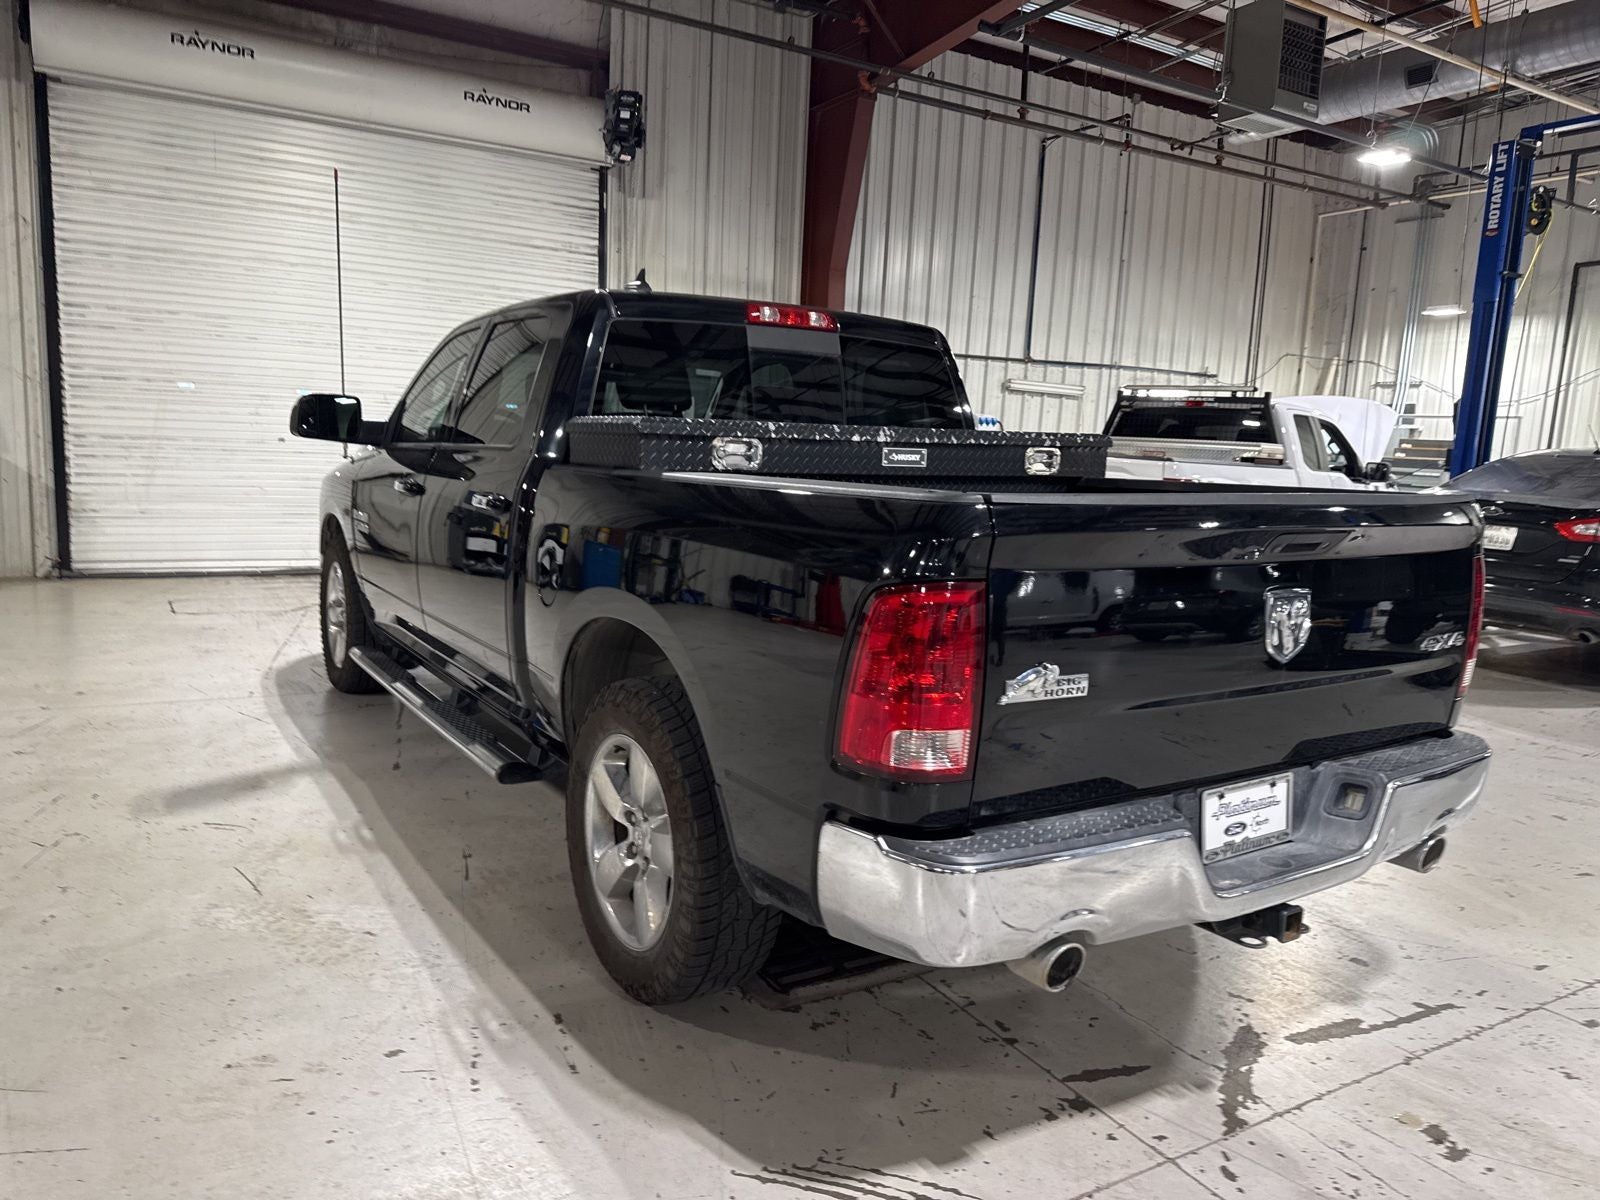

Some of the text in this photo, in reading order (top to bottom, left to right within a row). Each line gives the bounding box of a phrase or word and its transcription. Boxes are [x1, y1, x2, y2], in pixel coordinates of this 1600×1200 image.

[170, 30, 255, 60] RAYNOR
[463, 88, 531, 113] RAYNOR
[1487, 143, 1510, 230] ROTARY LIFT
[1044, 685, 1086, 698] HORN
[1056, 678, 1082, 687] BIG
[1211, 795, 1281, 821] Platinum
[1219, 836, 1275, 857] Platinum
